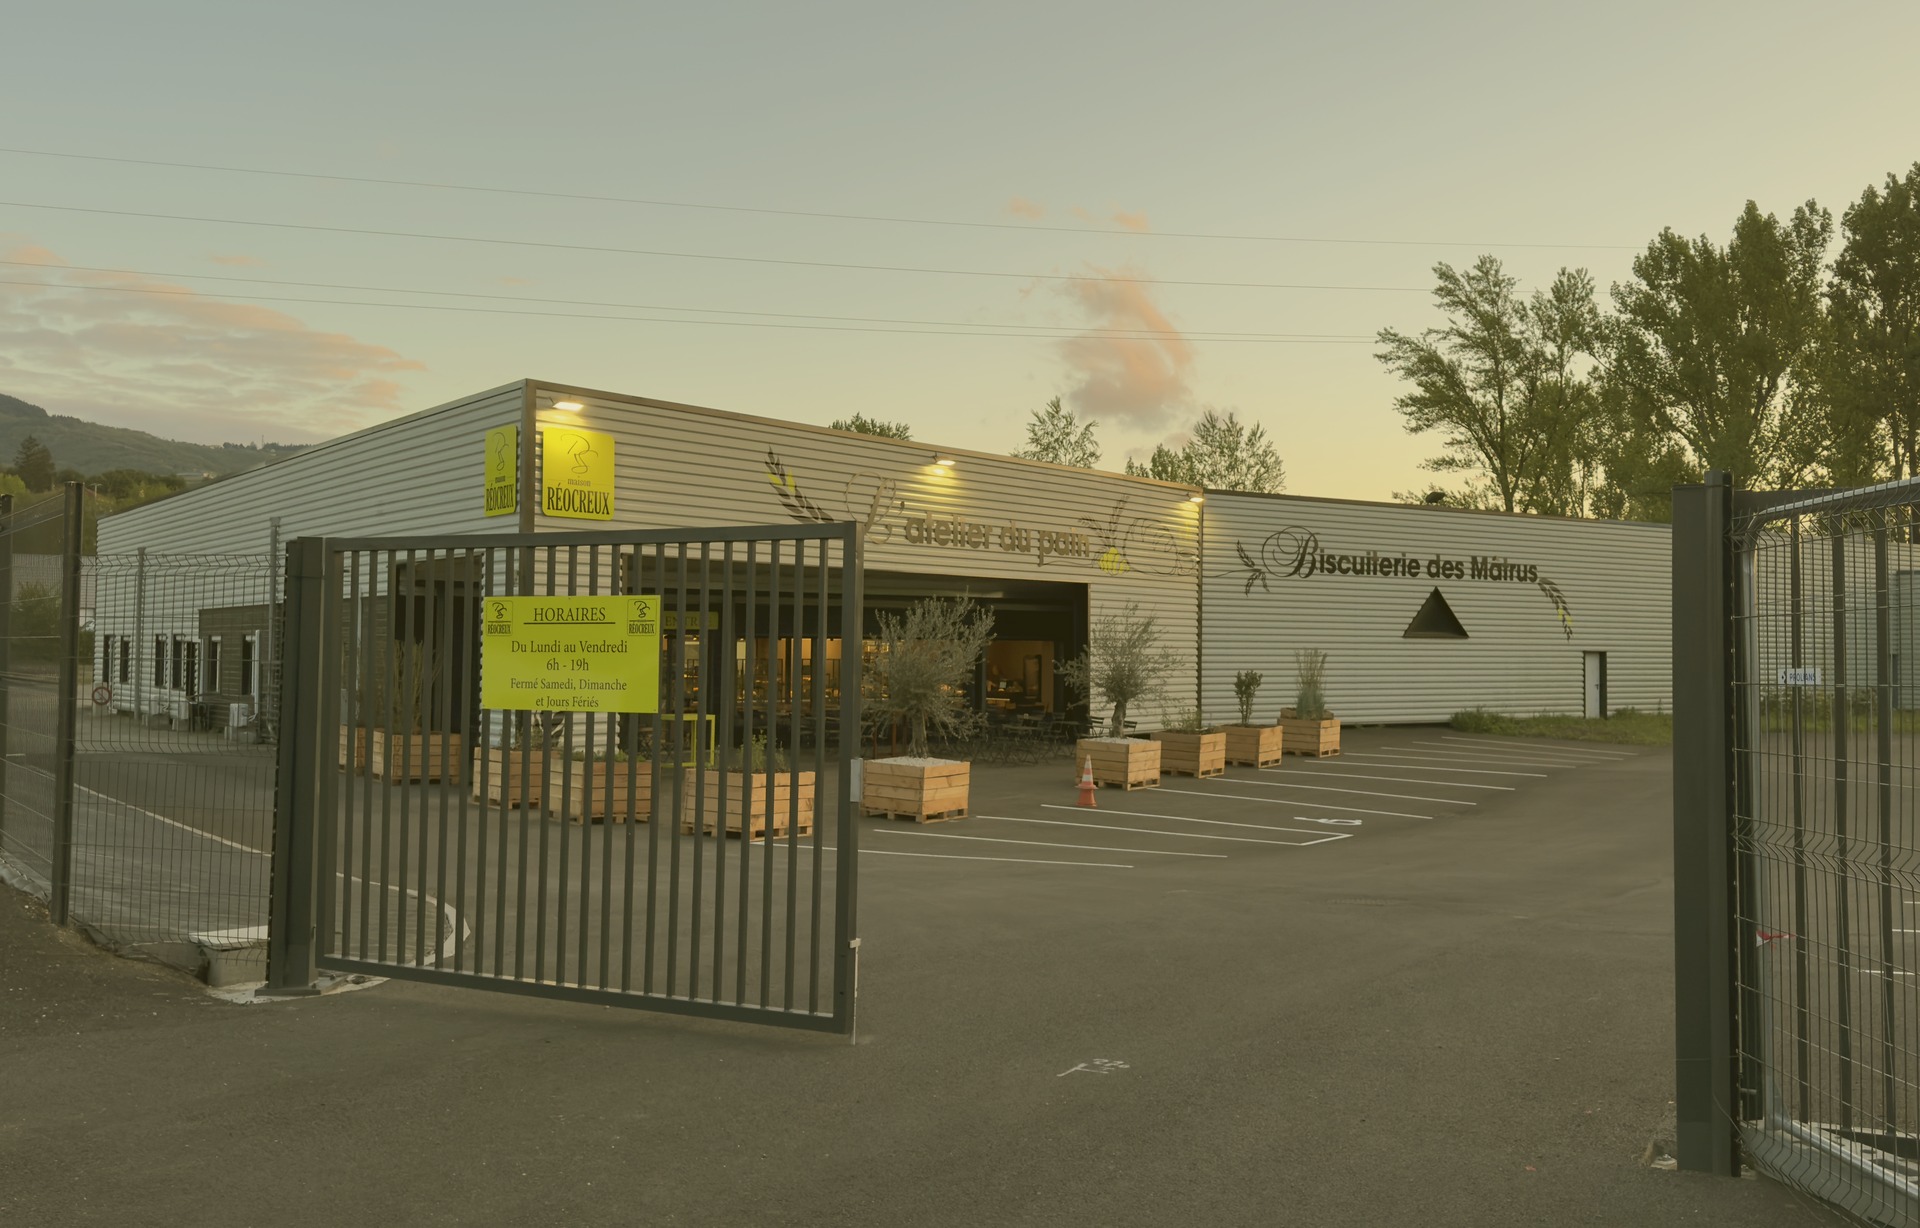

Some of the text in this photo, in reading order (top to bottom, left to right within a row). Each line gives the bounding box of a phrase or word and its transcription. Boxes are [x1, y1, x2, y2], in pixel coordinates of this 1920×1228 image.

[568, 478, 591, 487] maison
[486, 483, 514, 512] RÉOCREUX
[547, 483, 610, 515] RÉOCREUX
[1000, 520, 1032, 552] du
[1037, 527, 1090, 567] pain
[1262, 525, 1420, 578] Biscuiterie
[1426, 553, 1465, 580] des
[534, 607, 606, 621] HORAIRES
[511, 640, 628, 653] Du Lundi au Vendredi
[546, 658, 560, 671] 6h
[571, 658, 589, 671] 19h
[1789, 672, 1816, 682] PROLANS
[510, 678, 627, 691] Fermé Samedi, Dimanche
[536, 696, 599, 708] et Jours Fériés
